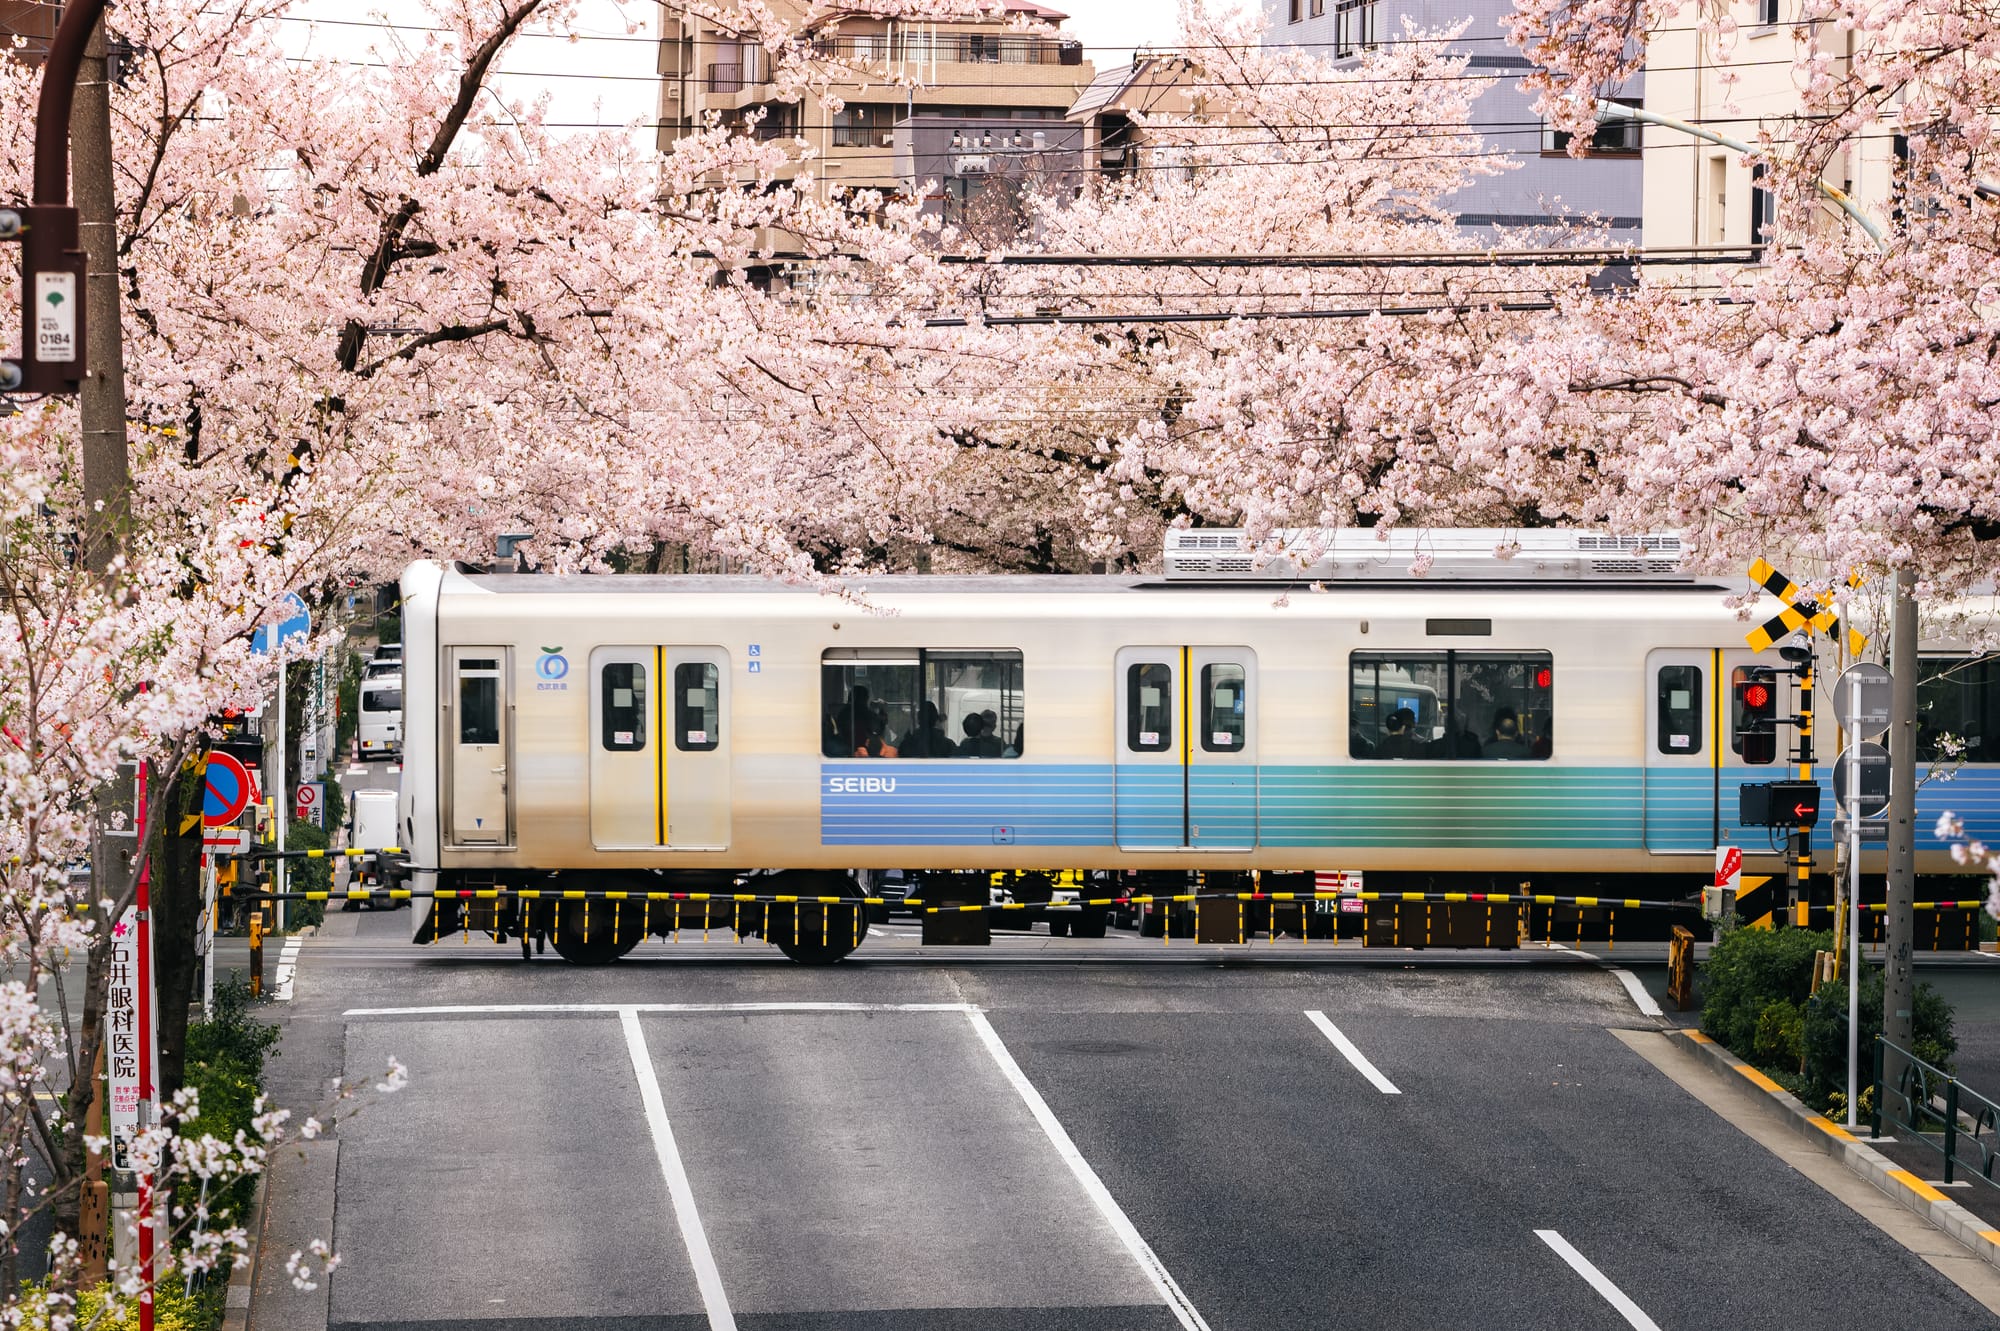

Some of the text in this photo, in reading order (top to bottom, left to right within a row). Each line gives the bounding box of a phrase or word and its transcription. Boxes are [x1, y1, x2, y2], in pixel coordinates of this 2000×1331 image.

[40, 333, 70, 345] 0184
[830, 777, 896, 793] SEIBU
[110, 941, 136, 1078] 石井眼科医院
